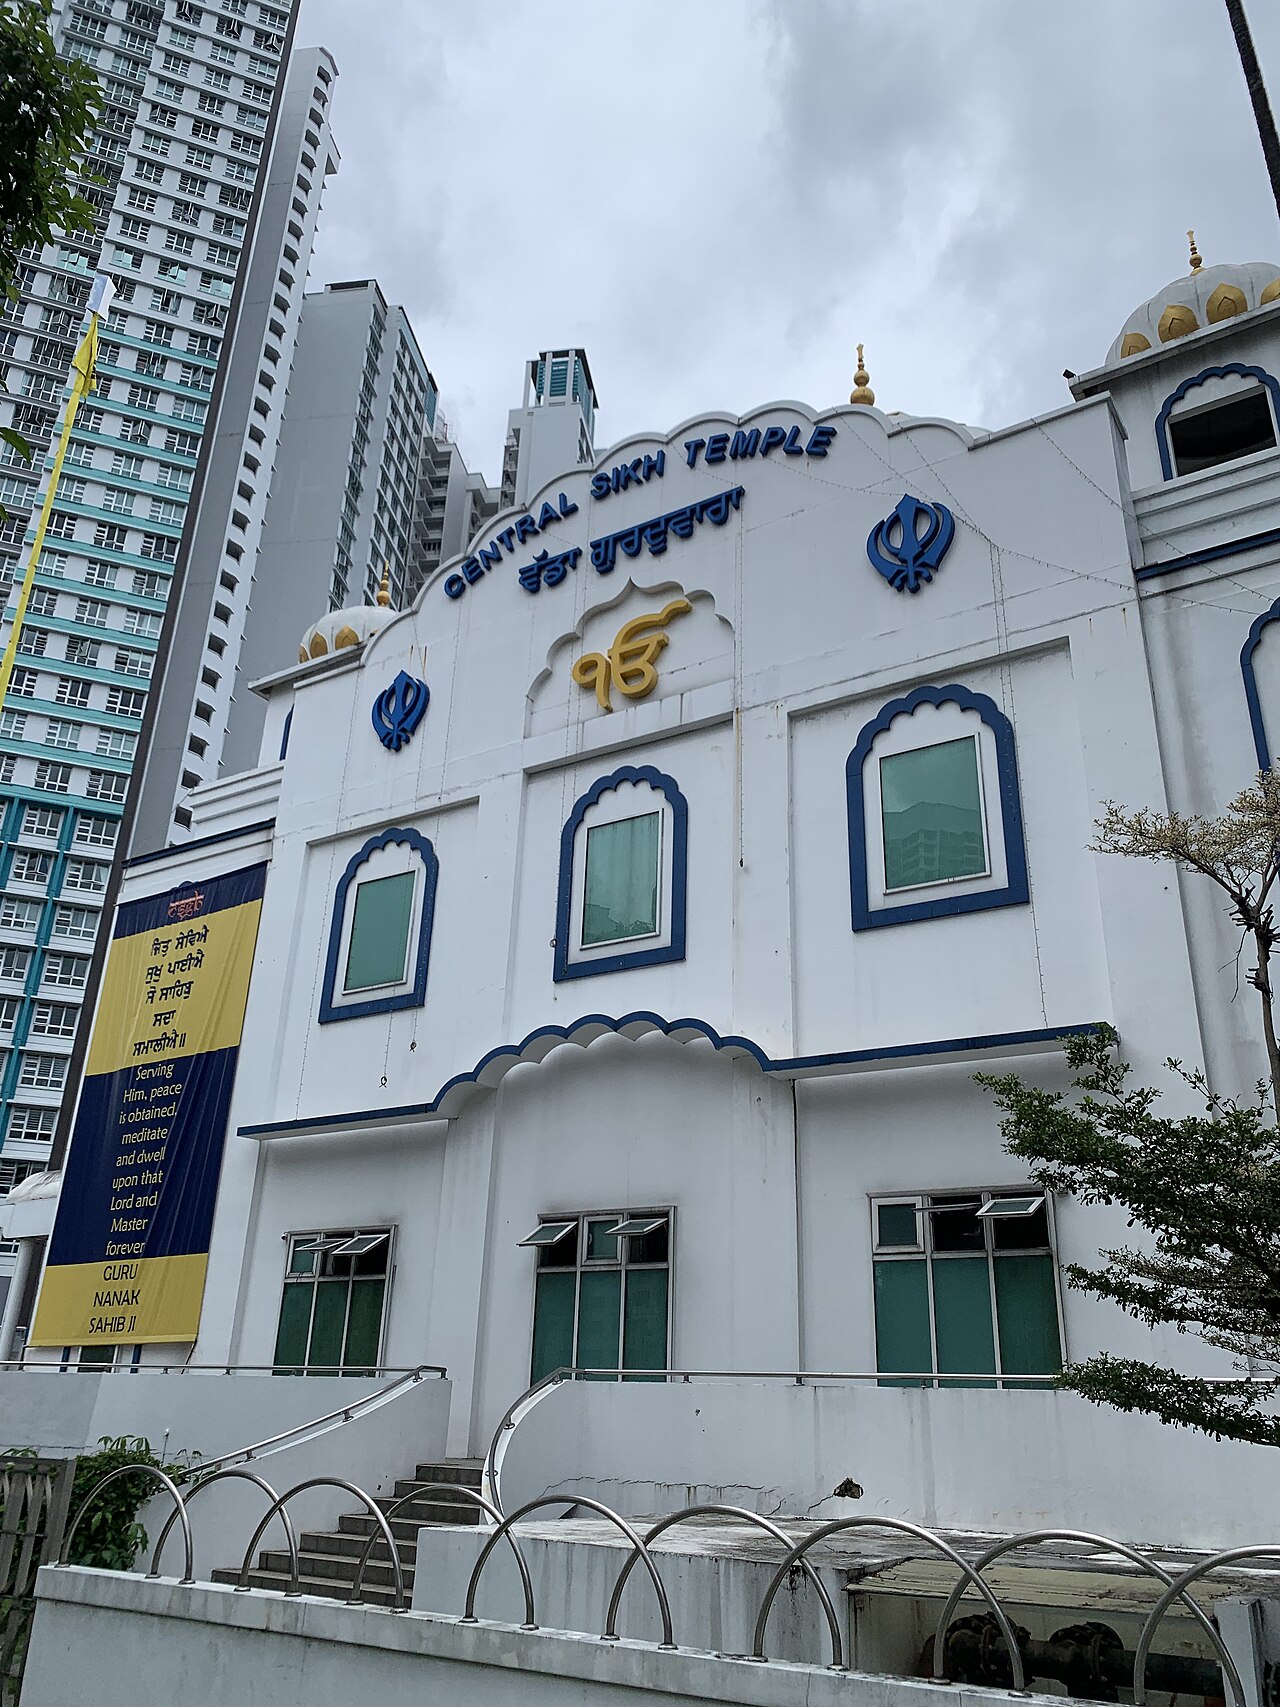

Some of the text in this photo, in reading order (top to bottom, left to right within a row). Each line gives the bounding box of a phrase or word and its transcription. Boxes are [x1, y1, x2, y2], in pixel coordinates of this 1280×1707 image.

[443, 424, 838, 600] CENTRAL SIKH TEMPLE
[518, 547, 583, 594] ਵੱਡਾ
[152, 1009, 177, 1028] ਸਦਾ
[136, 1063, 175, 1081] Serving
[149, 1082, 182, 1103] peace
[118, 1111, 126, 1125] is
[121, 1126, 168, 1145] meditate
[115, 1145, 167, 1167] and dwell
[112, 1169, 164, 1192] upon that
[110, 1190, 158, 1211] Lord and
[110, 1216, 149, 1233] Master
[105, 1240, 146, 1256] forever
[103, 1263, 139, 1281] GURU
[92, 1288, 142, 1308] NANAK
[88, 1315, 137, 1334] SAHIB JI
